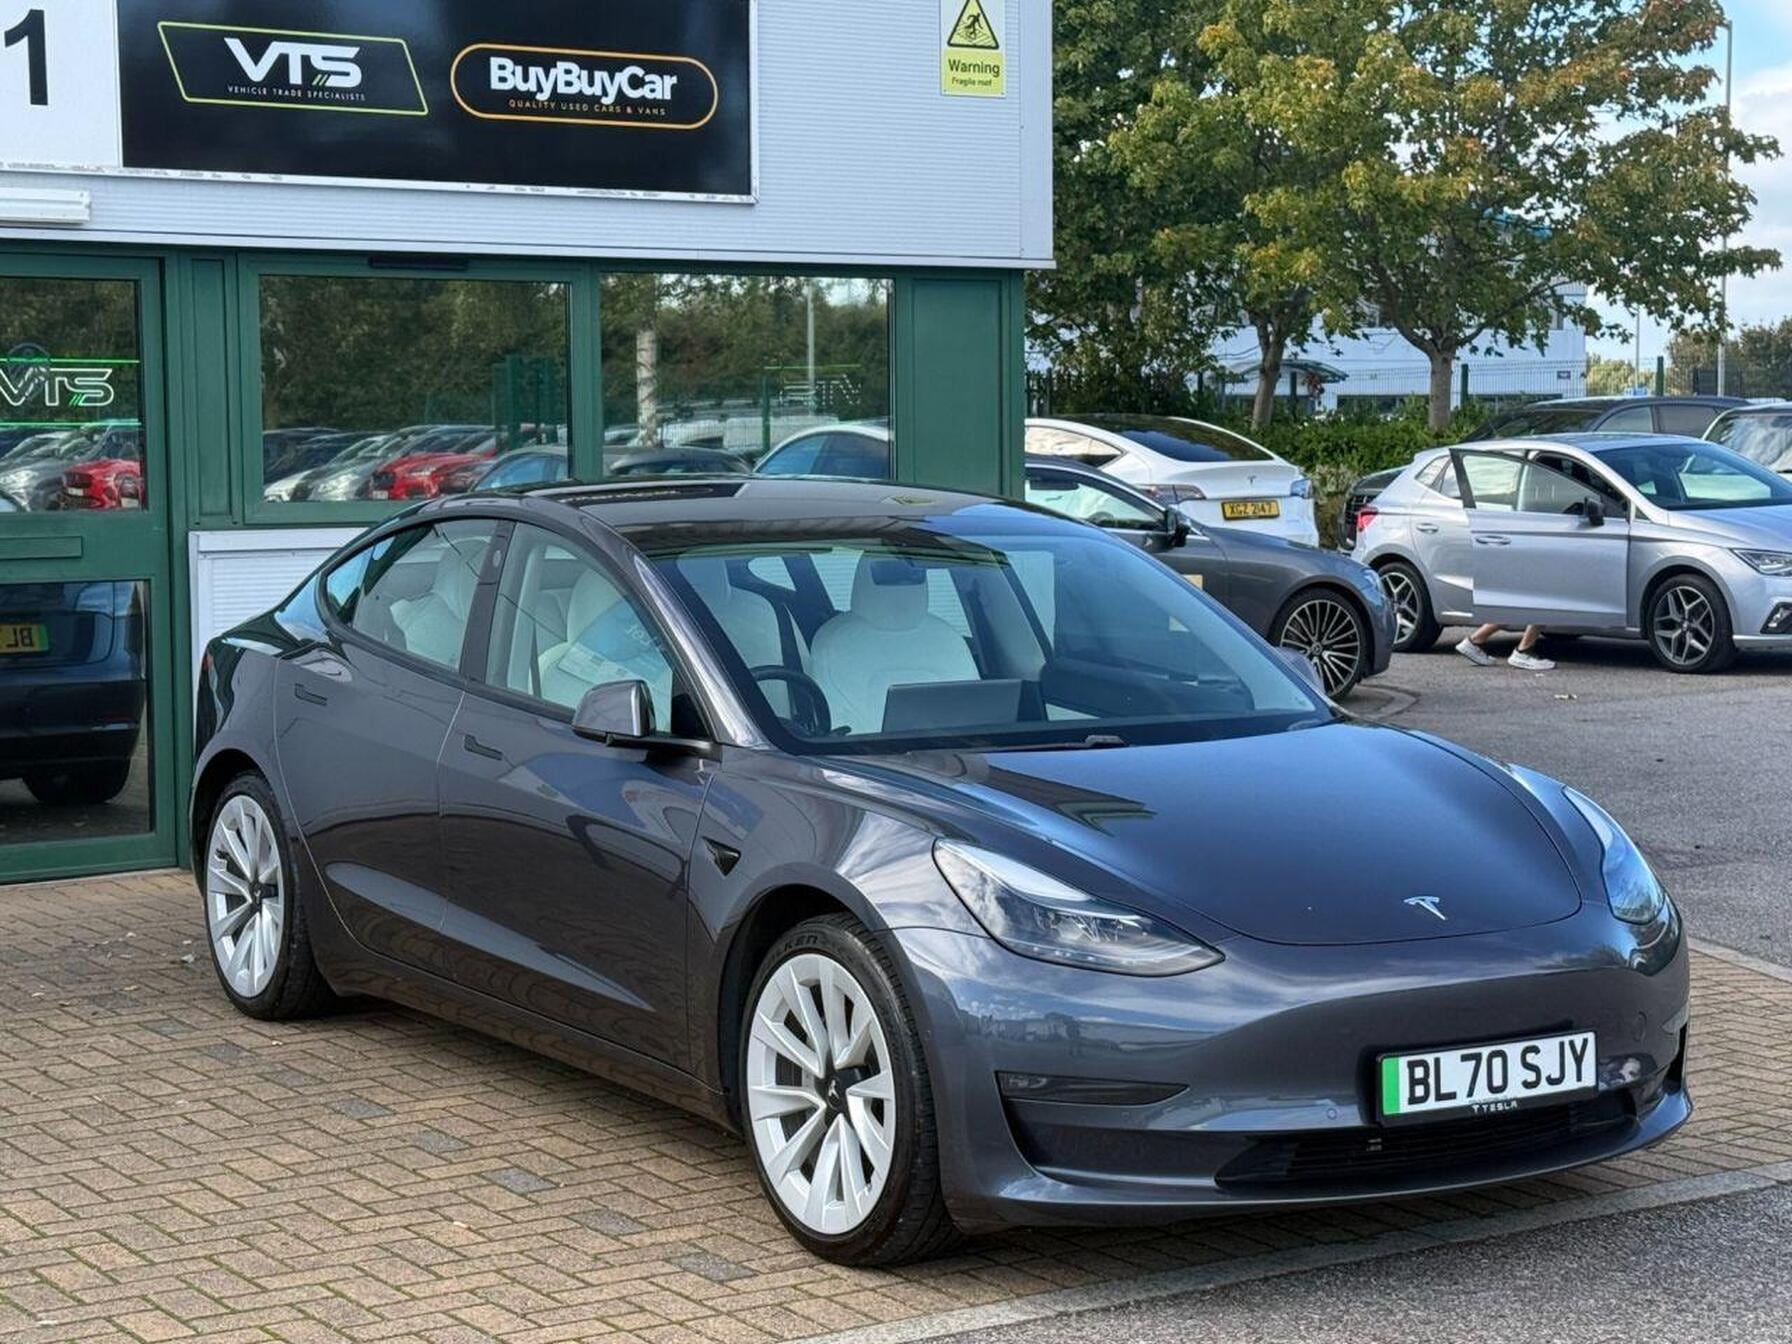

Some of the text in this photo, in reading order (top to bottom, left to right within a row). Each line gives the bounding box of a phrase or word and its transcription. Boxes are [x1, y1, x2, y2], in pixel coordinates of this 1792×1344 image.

[4, 9, 48, 106] 1
[223, 37, 362, 88] VTS
[948, 59, 1000, 78] Warning
[226, 85, 366, 101] VEHICLE TRADE SPECIALISTS
[489, 56, 678, 105] BuyBuyCar
[508, 99, 556, 110] QUALITY
[560, 102, 589, 112] USED
[594, 103, 622, 114] CARS
[637, 106, 666, 116] VANS
[0, 366, 115, 407] VTS
[1406, 1037, 1589, 1105] BL70 SJY
